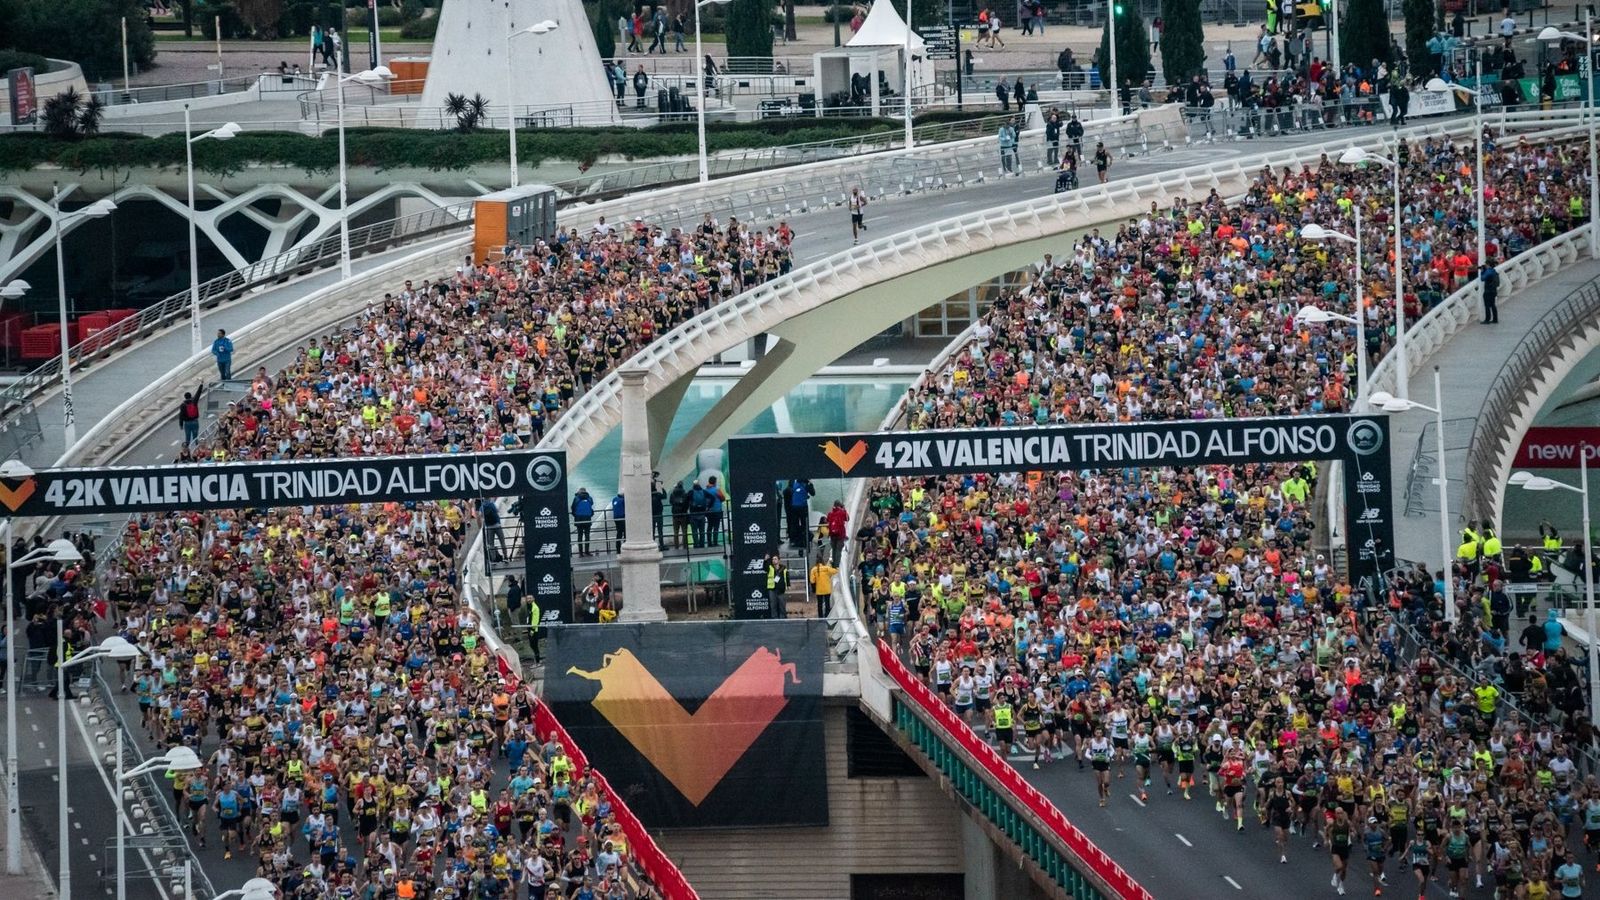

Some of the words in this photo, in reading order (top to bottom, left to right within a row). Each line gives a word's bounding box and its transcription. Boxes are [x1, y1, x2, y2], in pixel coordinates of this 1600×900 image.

[875, 440, 932, 469] 42K
[936, 435, 1071, 467] VALENCIA
[1073, 430, 1201, 461] TRINIDAD
[1204, 424, 1336, 457] ALFONSO
[1528, 444, 1575, 459] new
[45, 478, 105, 507] 42K
[110, 473, 249, 505] VALENCIA
[252, 467, 382, 500] TRINIDAD
[385, 460, 516, 495] ALFONSO
